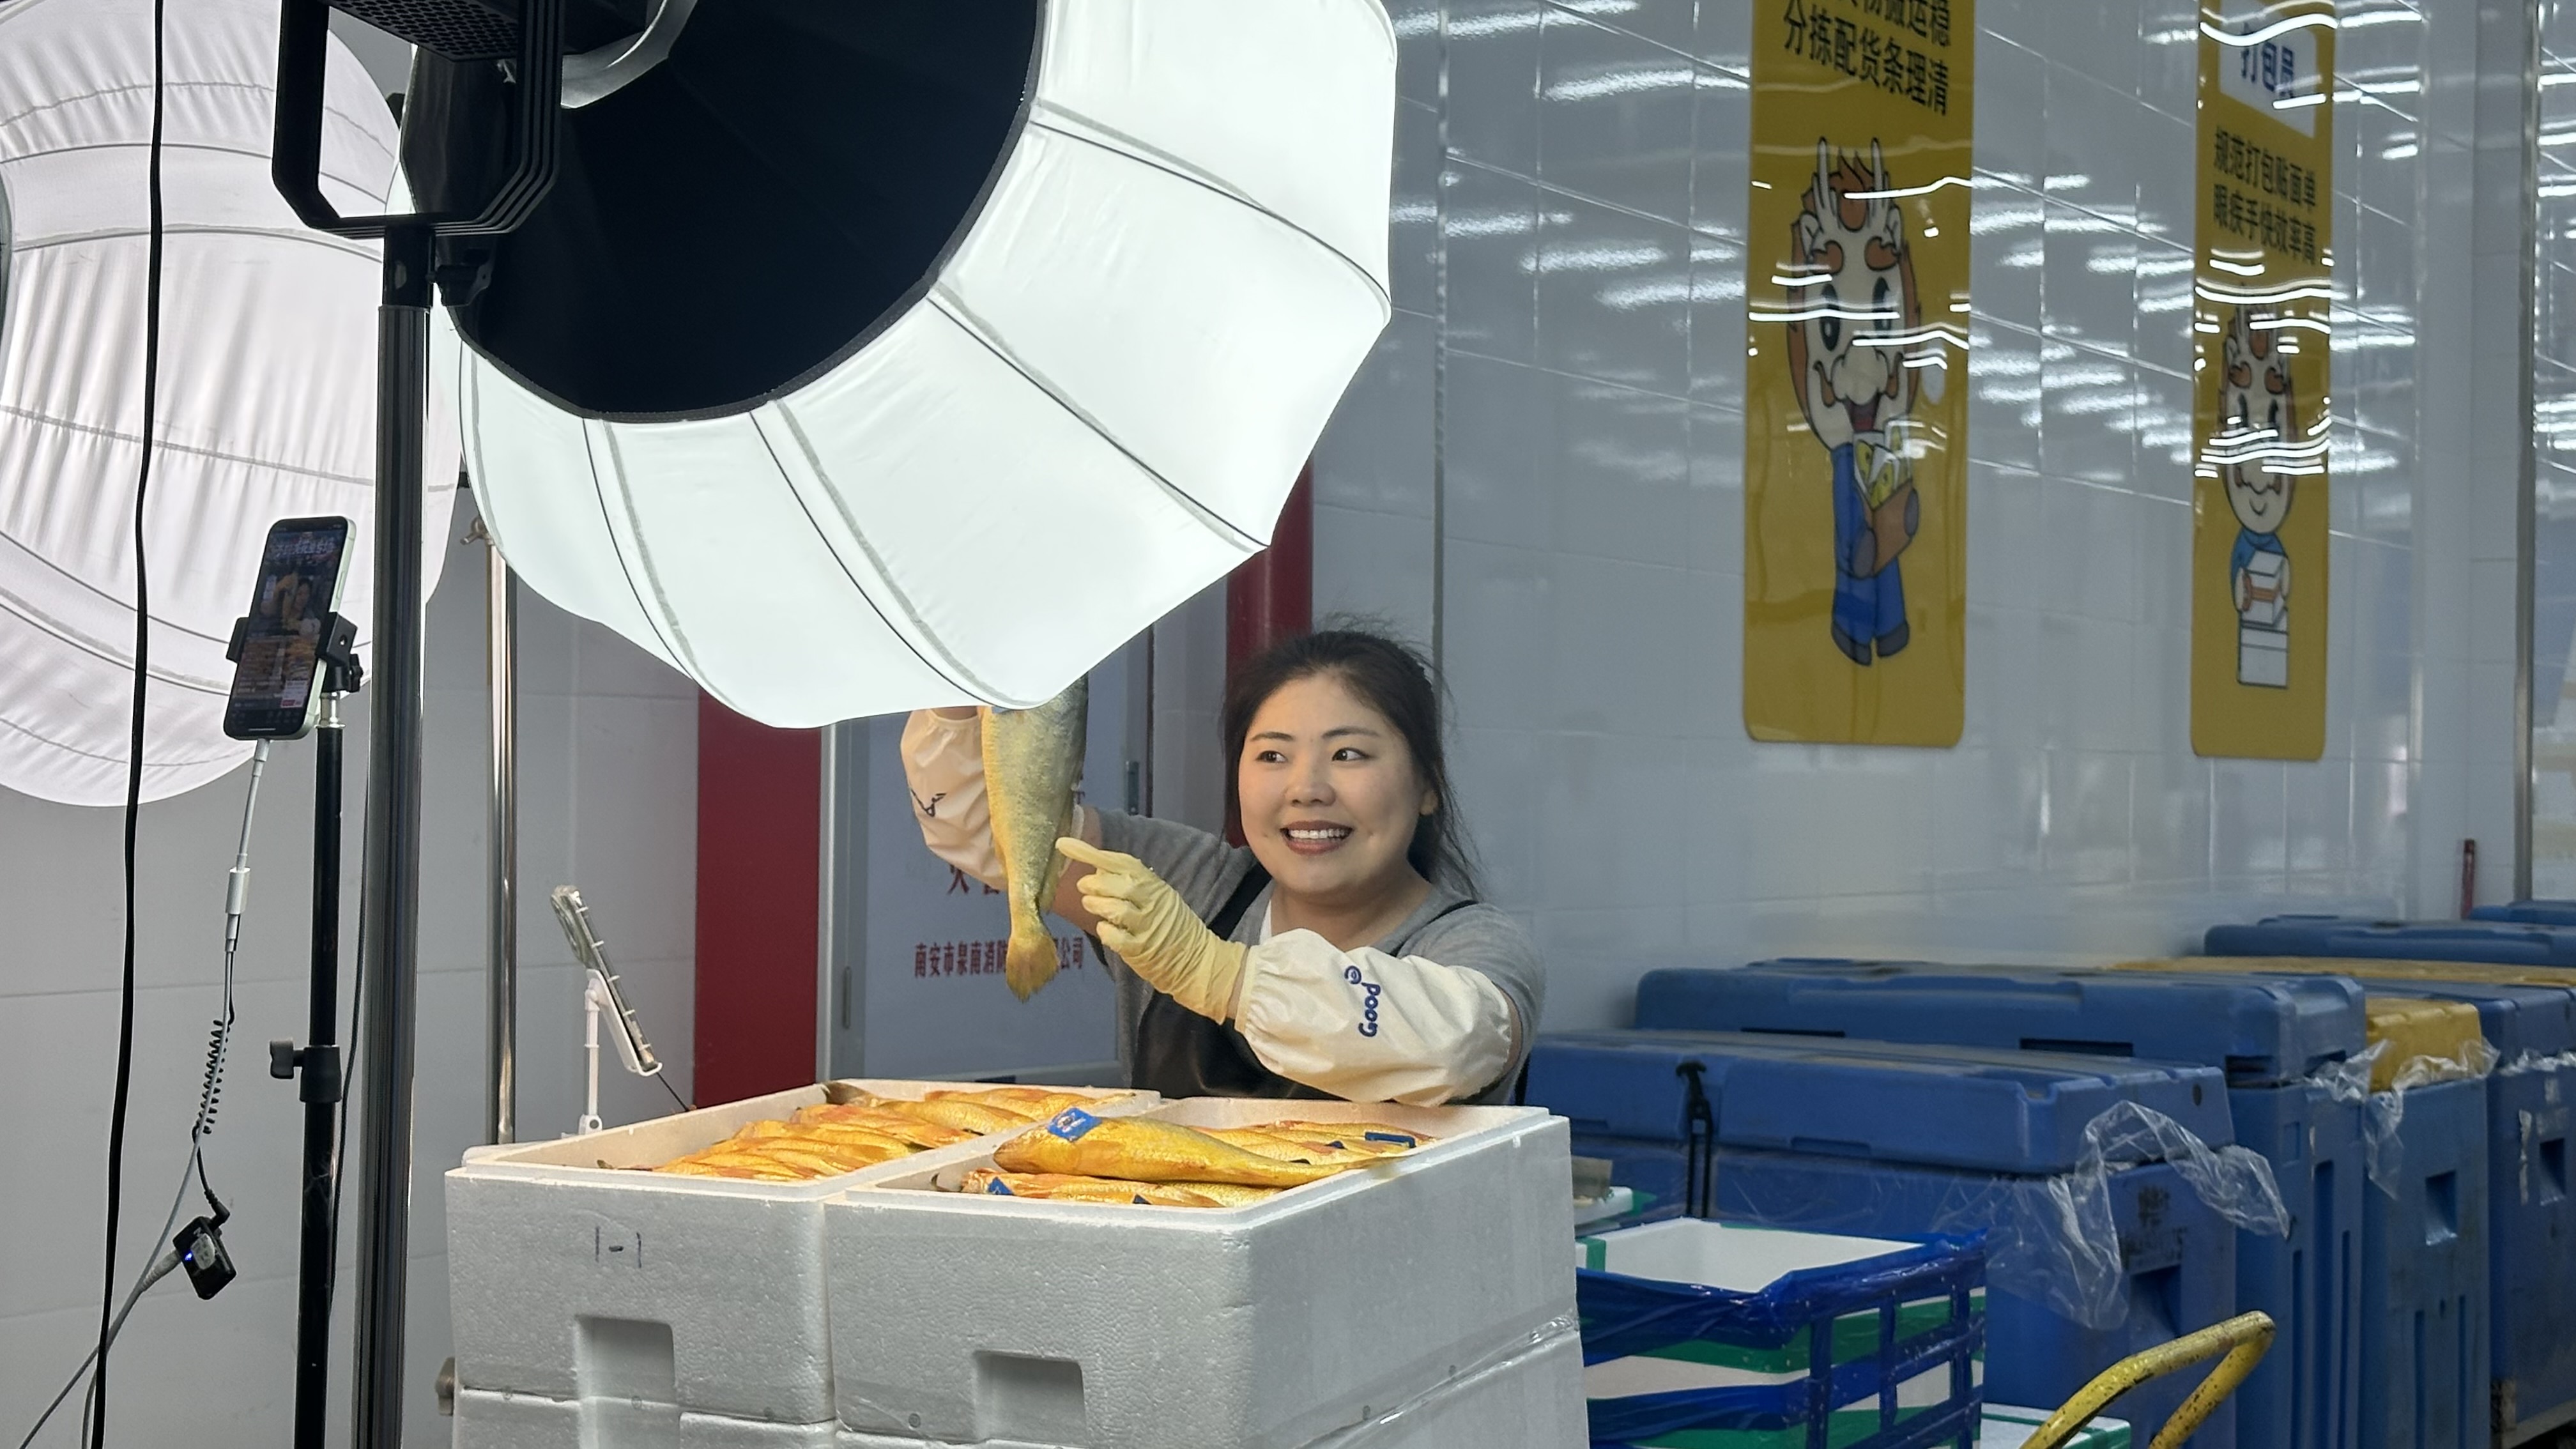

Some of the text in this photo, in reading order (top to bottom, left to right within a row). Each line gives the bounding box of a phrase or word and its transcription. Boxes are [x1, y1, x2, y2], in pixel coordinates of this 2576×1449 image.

[1783, 0, 1949, 116] 分拣配货条理清
[1358, 982, 1381, 1038] Good
